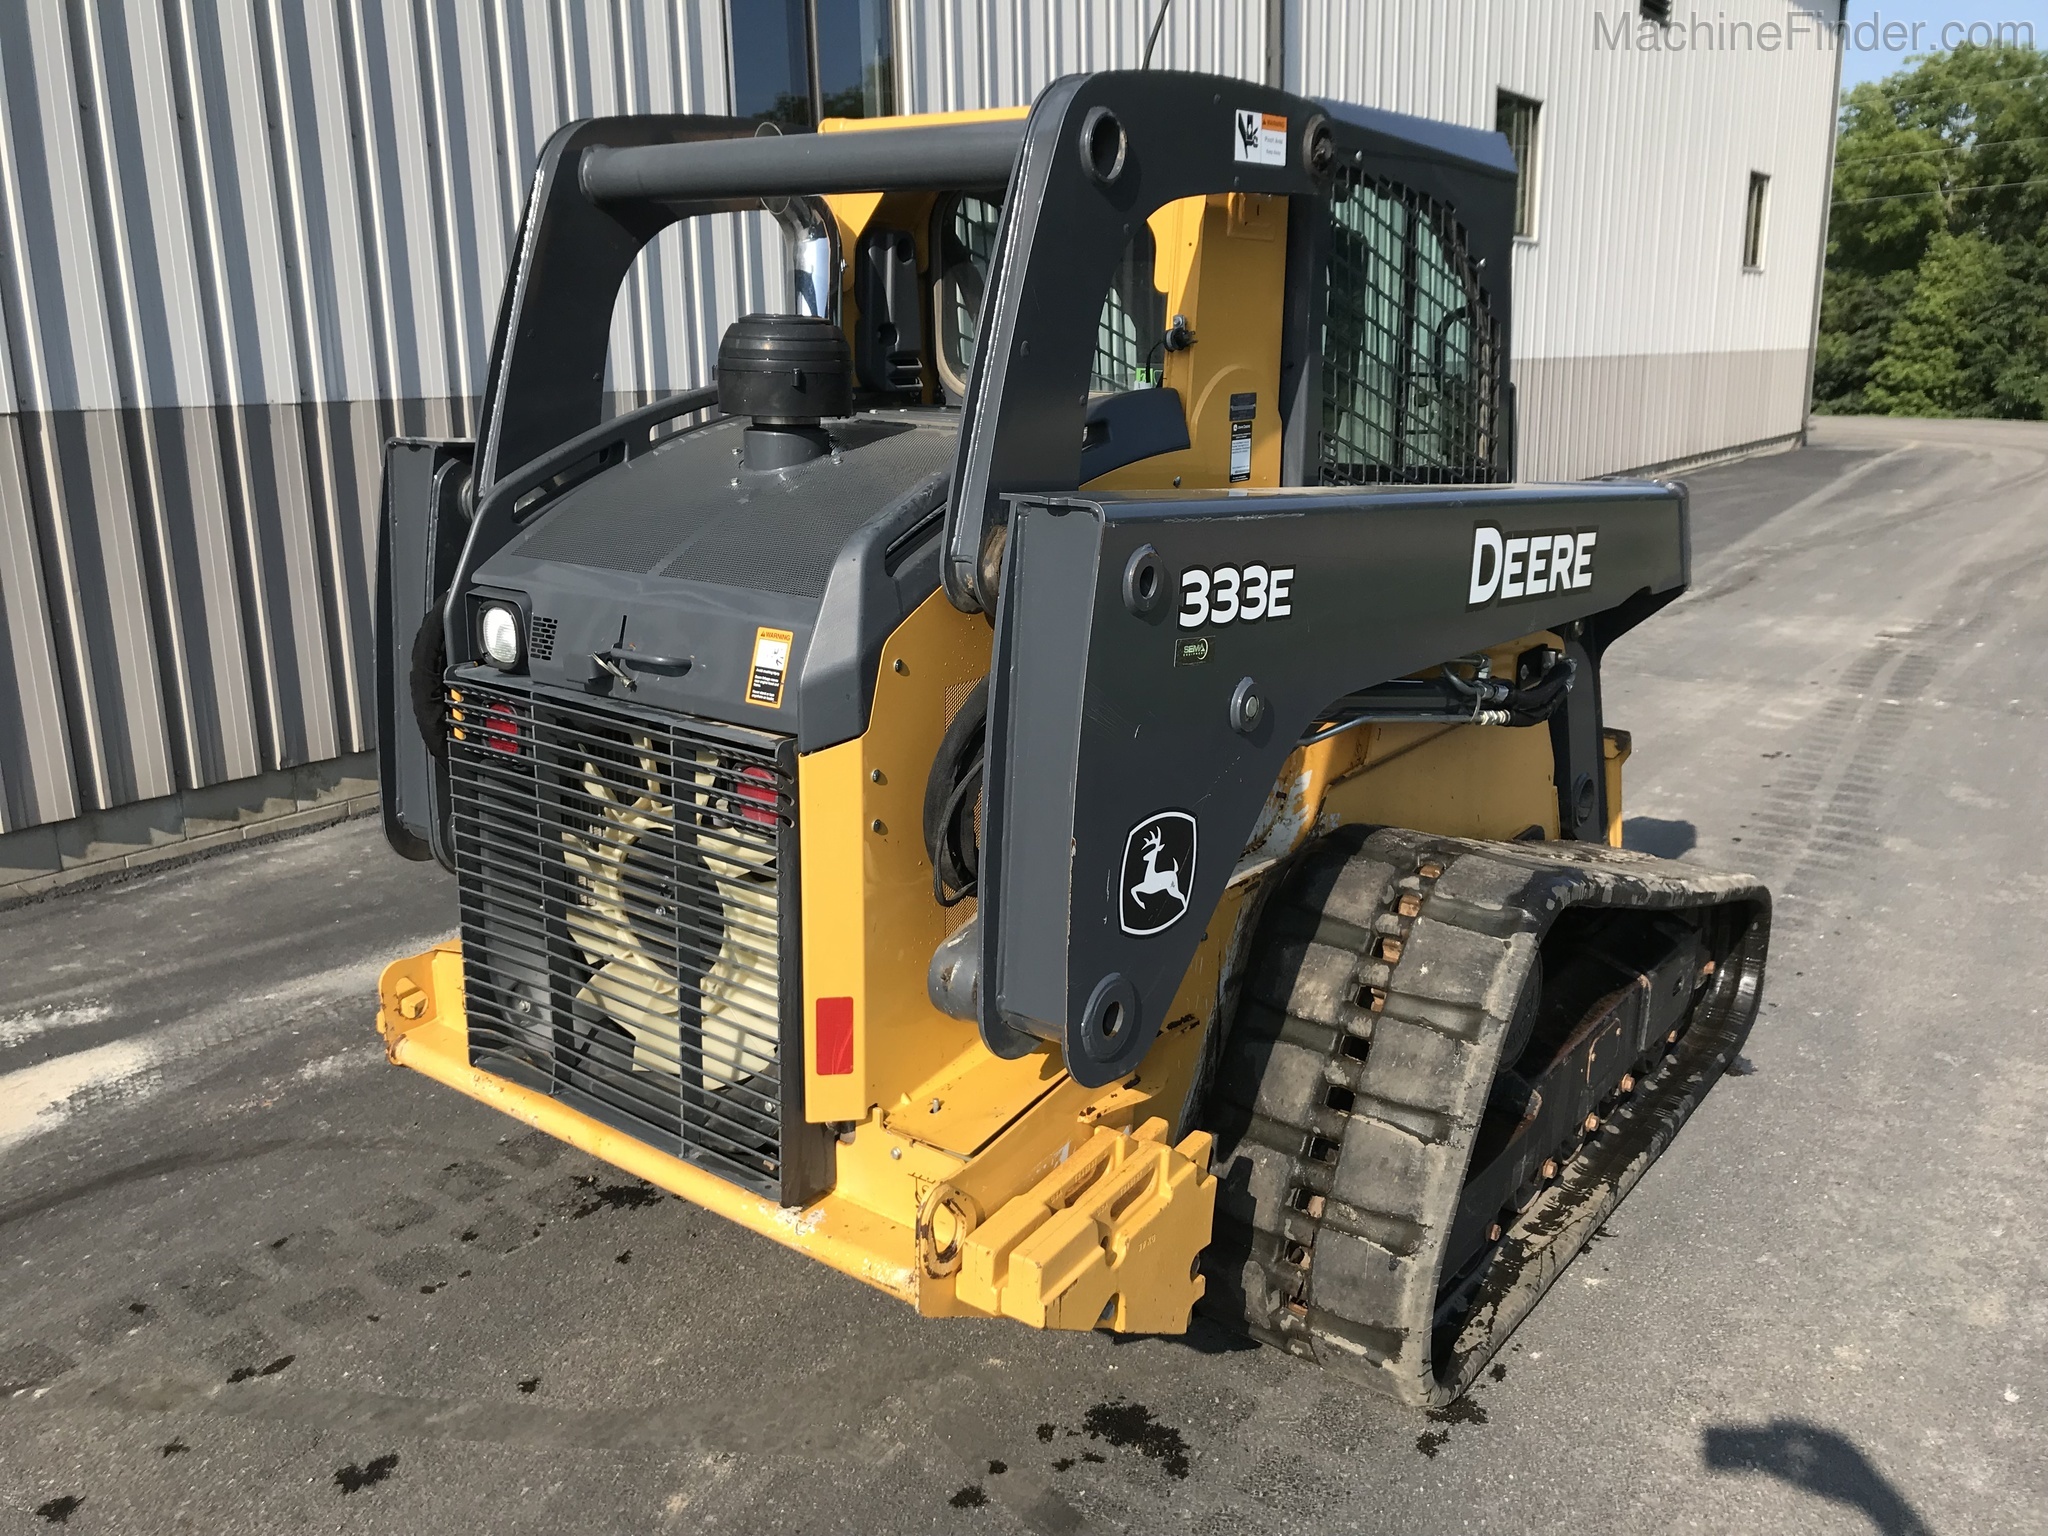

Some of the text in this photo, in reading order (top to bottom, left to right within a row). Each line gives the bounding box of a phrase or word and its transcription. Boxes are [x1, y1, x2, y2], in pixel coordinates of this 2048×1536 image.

[1179, 565, 1294, 627] 333E
[1469, 527, 1597, 604] DEERE
[765, 631, 791, 641] WARNING
